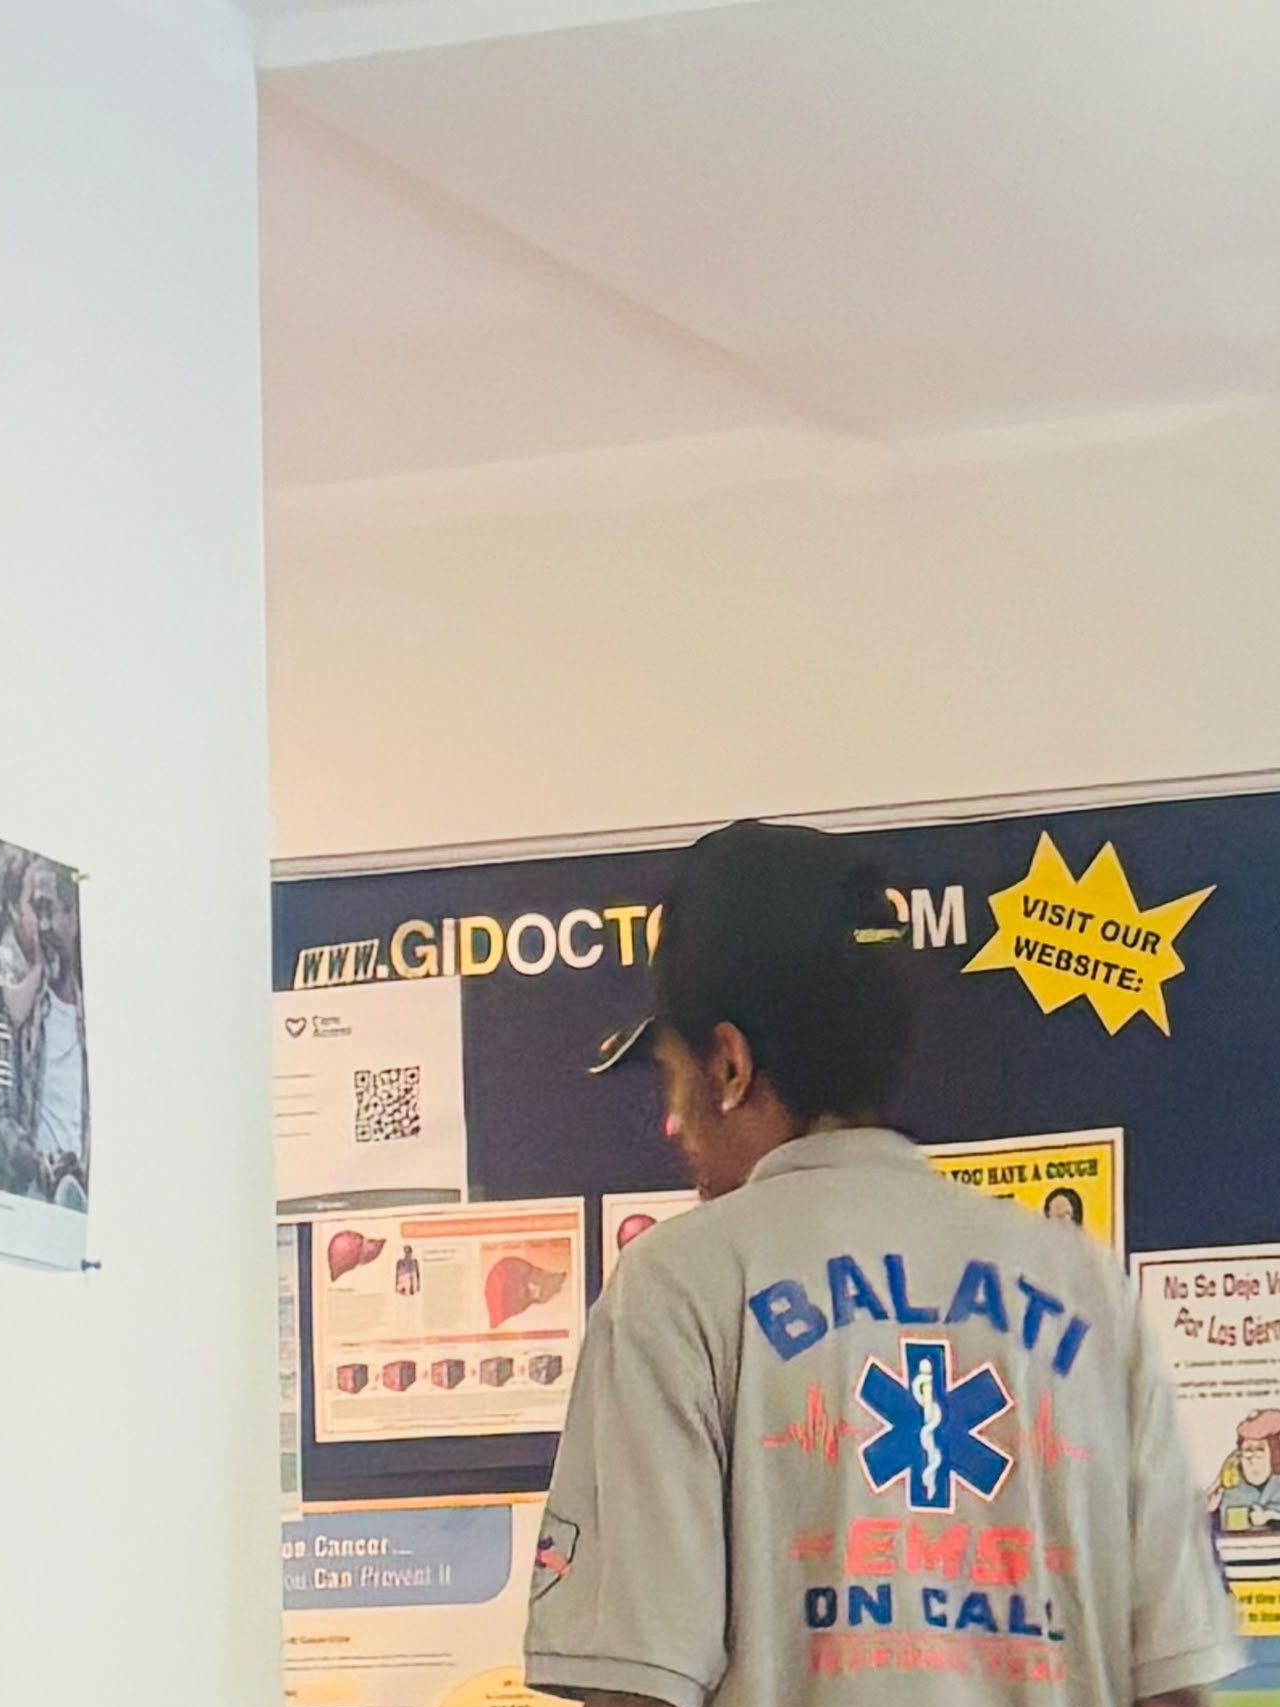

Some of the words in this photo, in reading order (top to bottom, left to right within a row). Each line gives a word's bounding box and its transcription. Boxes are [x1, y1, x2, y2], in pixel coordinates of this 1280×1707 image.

[1023, 895, 1095, 934] VISIT
[1101, 919, 1161, 955] OUR
[1015, 935, 1143, 992] WEBSITE:
[988, 1164, 1027, 1185] HAVE
[1031, 1163, 1042, 1181] A
[1163, 1275, 1189, 1300] No
[1194, 1273, 1217, 1298] Se
[1223, 1273, 1260, 1301] Deje
[748, 1254, 1092, 1378] BALATI
[1174, 1306, 1204, 1339] Por
[1208, 1315, 1237, 1347] Los
[844, 1517, 1034, 1586] EMS
[284, 1574, 307, 1590] ou
[314, 1567, 353, 1590] Can
[359, 1565, 433, 1588] Prevent
[804, 1584, 893, 1629] ON
